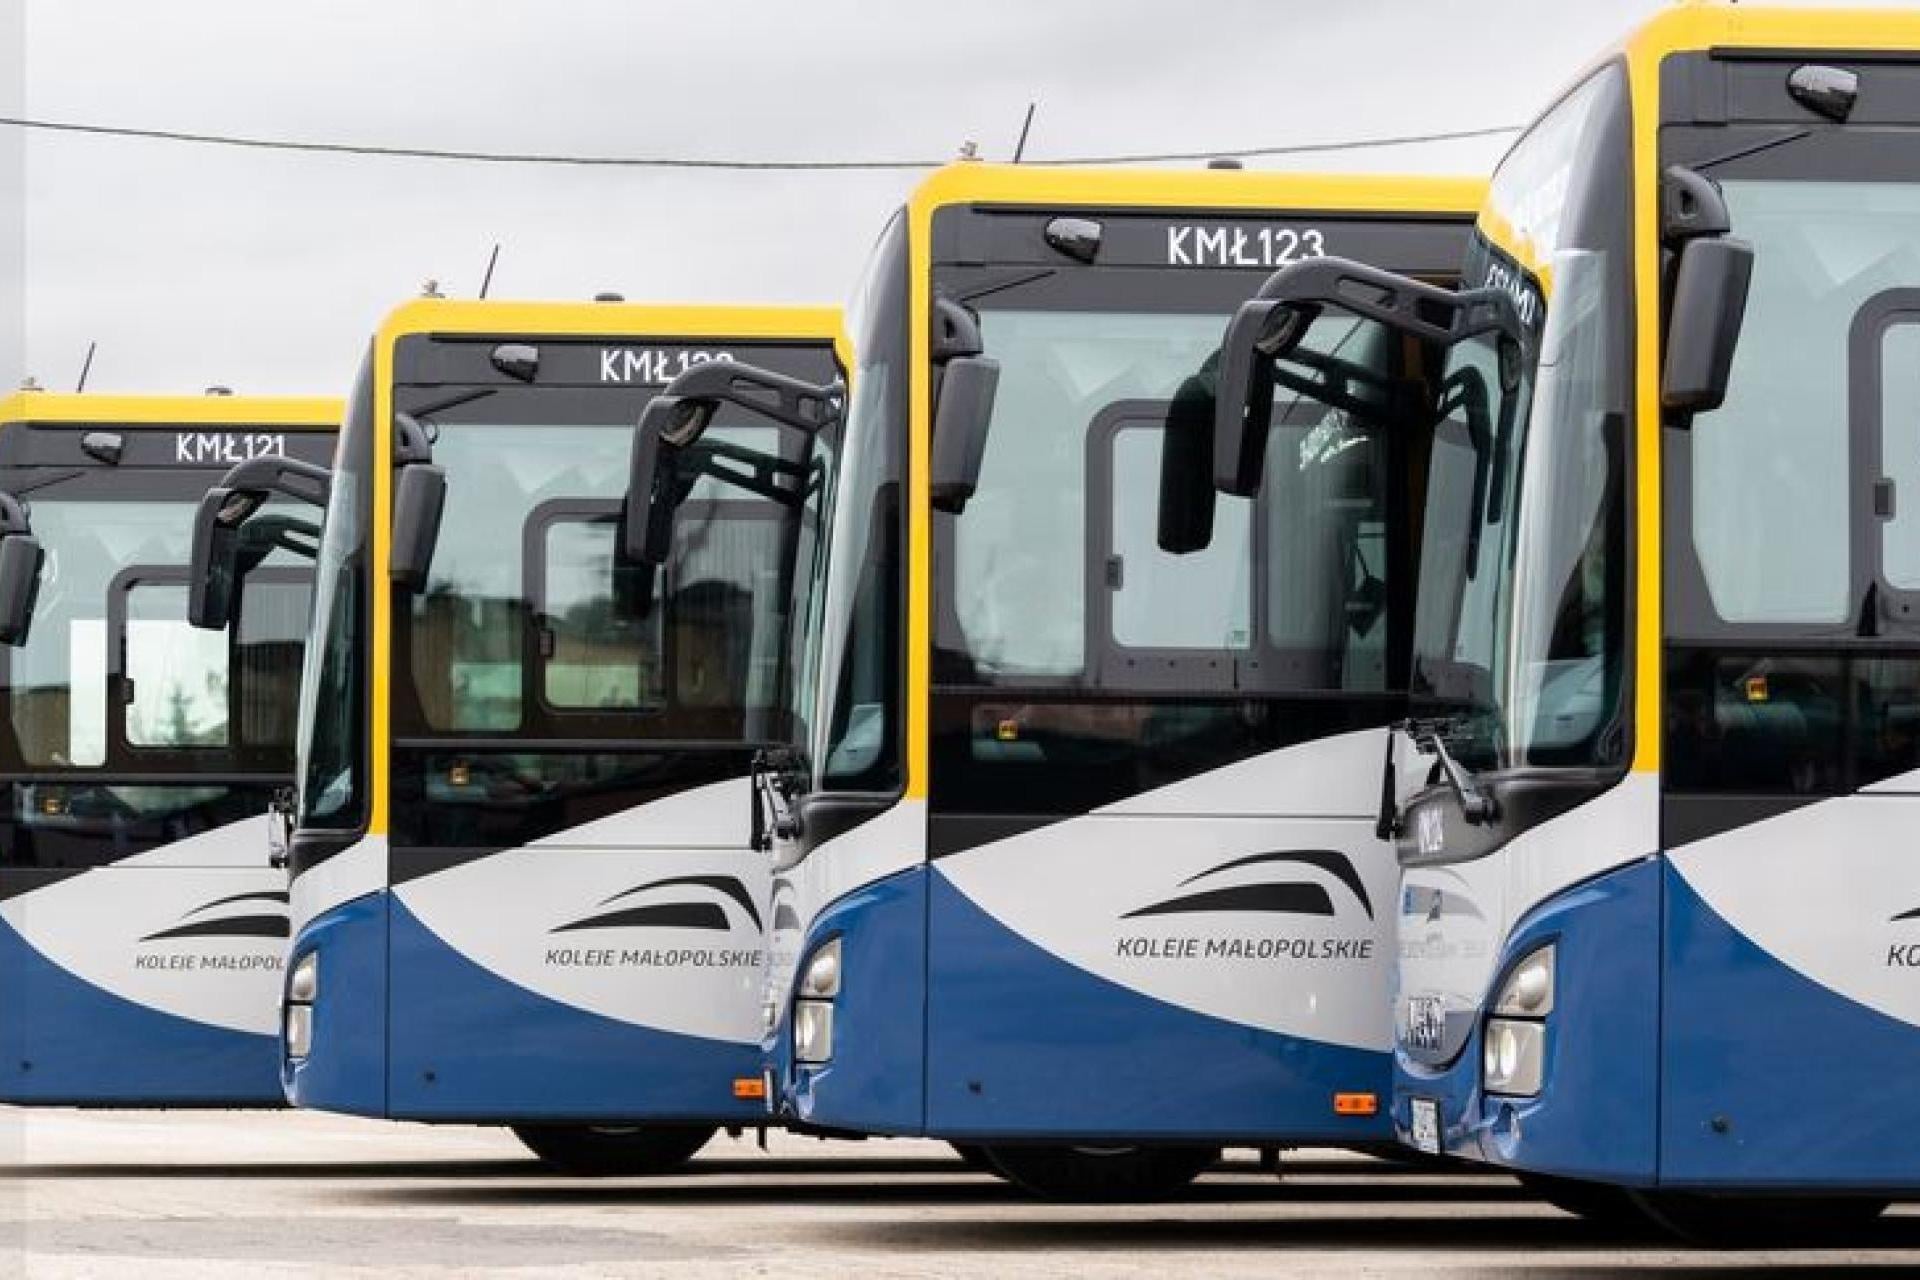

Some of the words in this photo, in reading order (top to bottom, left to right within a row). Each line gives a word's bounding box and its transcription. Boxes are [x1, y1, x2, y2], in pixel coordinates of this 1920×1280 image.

[1168, 226, 1325, 265] KMŁ123
[601, 350, 734, 382] KMŁ1
[176, 432, 285, 462] KMŁ121
[619, 949, 761, 967] MAŁOPOLSKIE
[1204, 938, 1374, 958] MAŁOPOLSKIE
